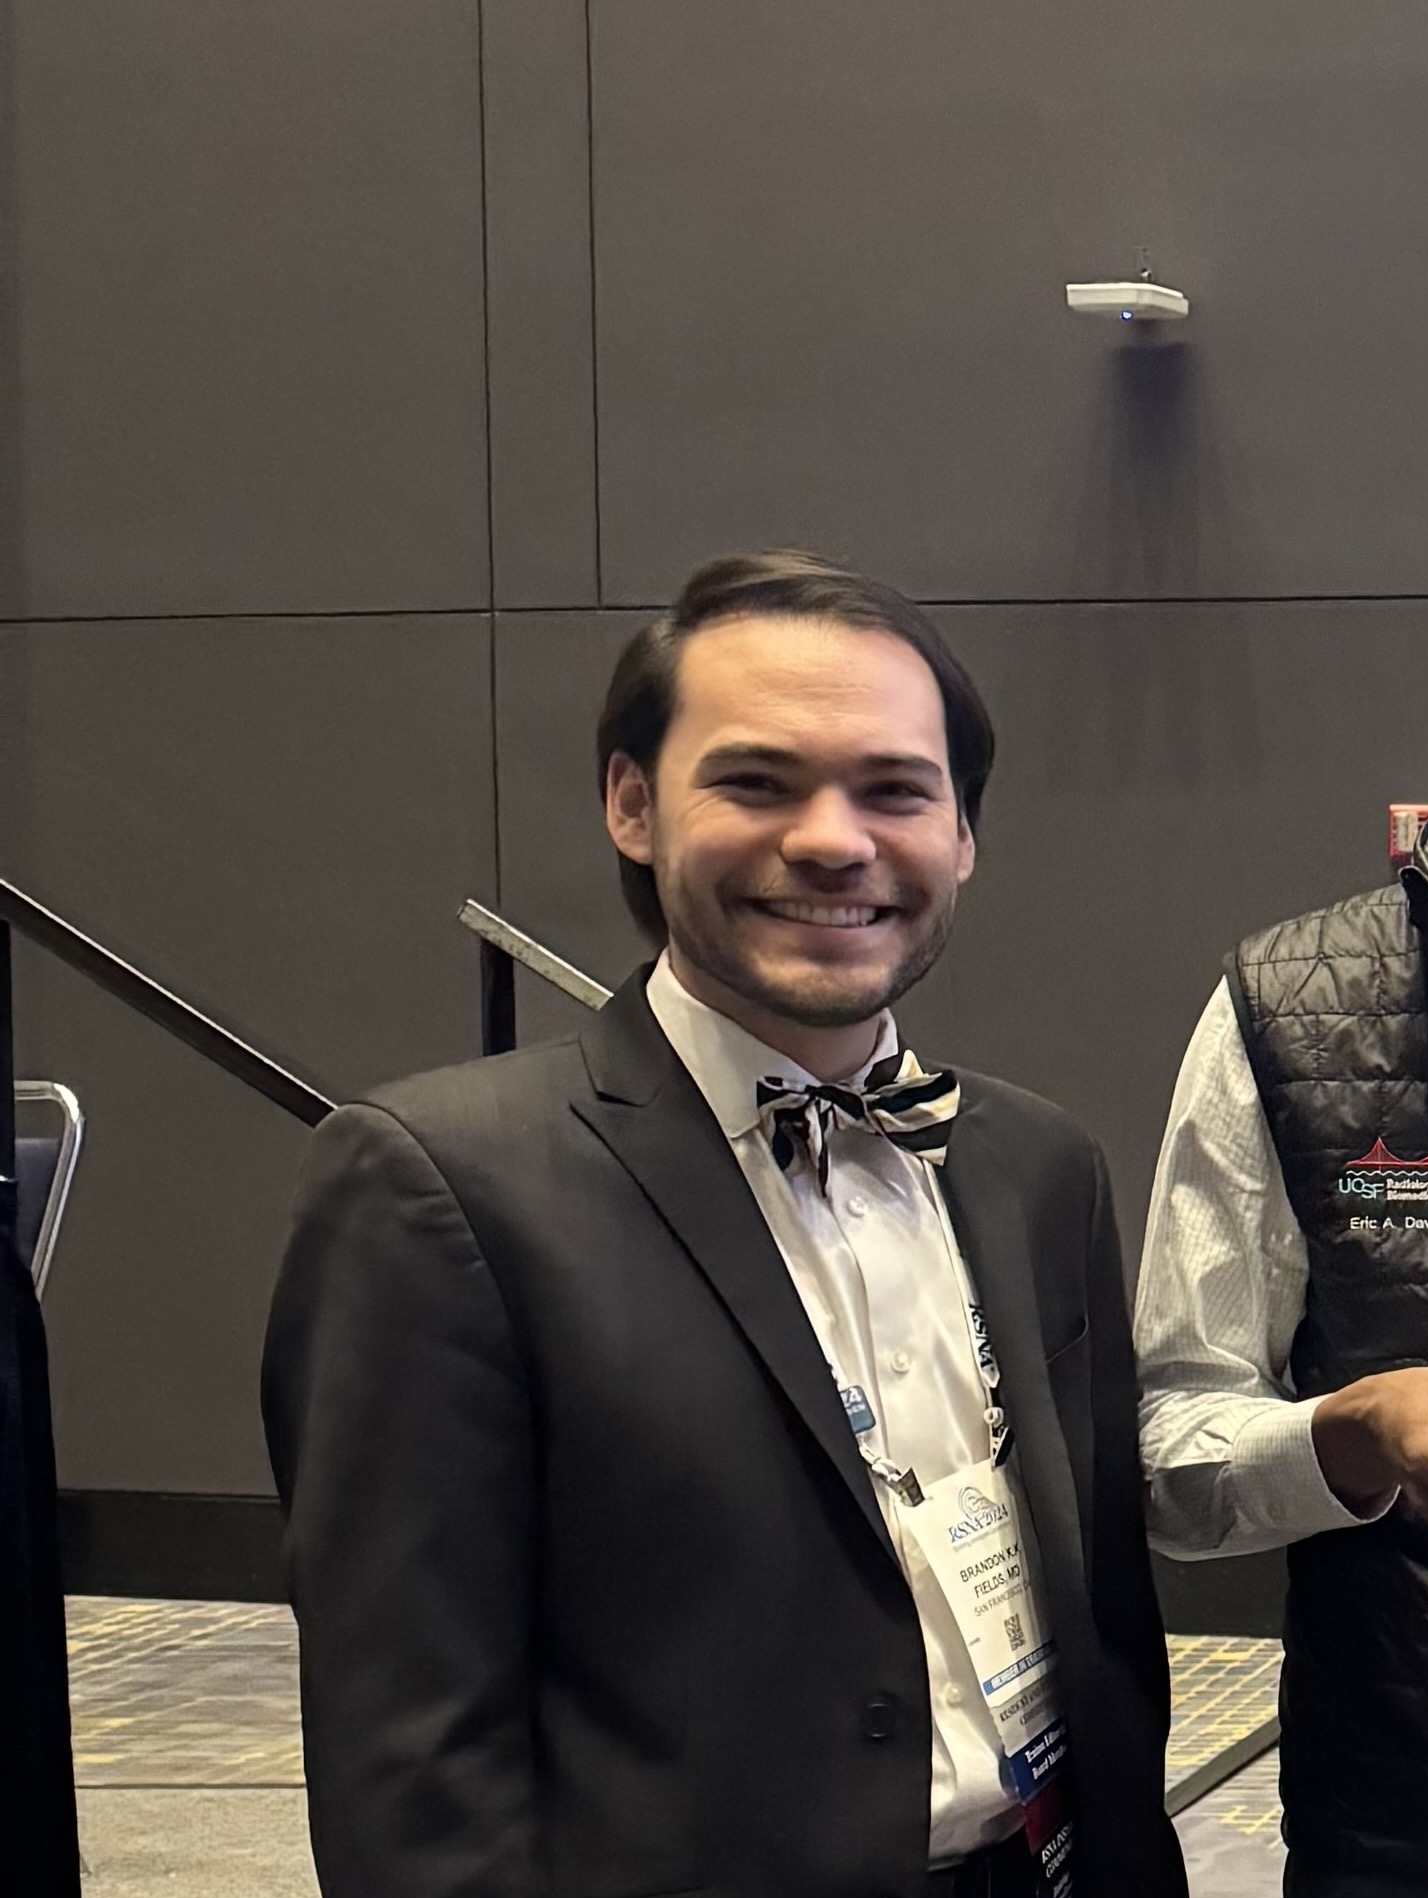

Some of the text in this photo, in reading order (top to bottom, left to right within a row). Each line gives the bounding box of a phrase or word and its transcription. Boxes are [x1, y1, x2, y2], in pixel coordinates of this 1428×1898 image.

[1338, 1177, 1385, 1200] UCSF
[1349, 1215, 1378, 1230] Eric
[959, 1550, 1006, 1583] BRANDON
[973, 1573, 1008, 1599] FIELDS,
[1006, 1564, 1021, 1579] MD
